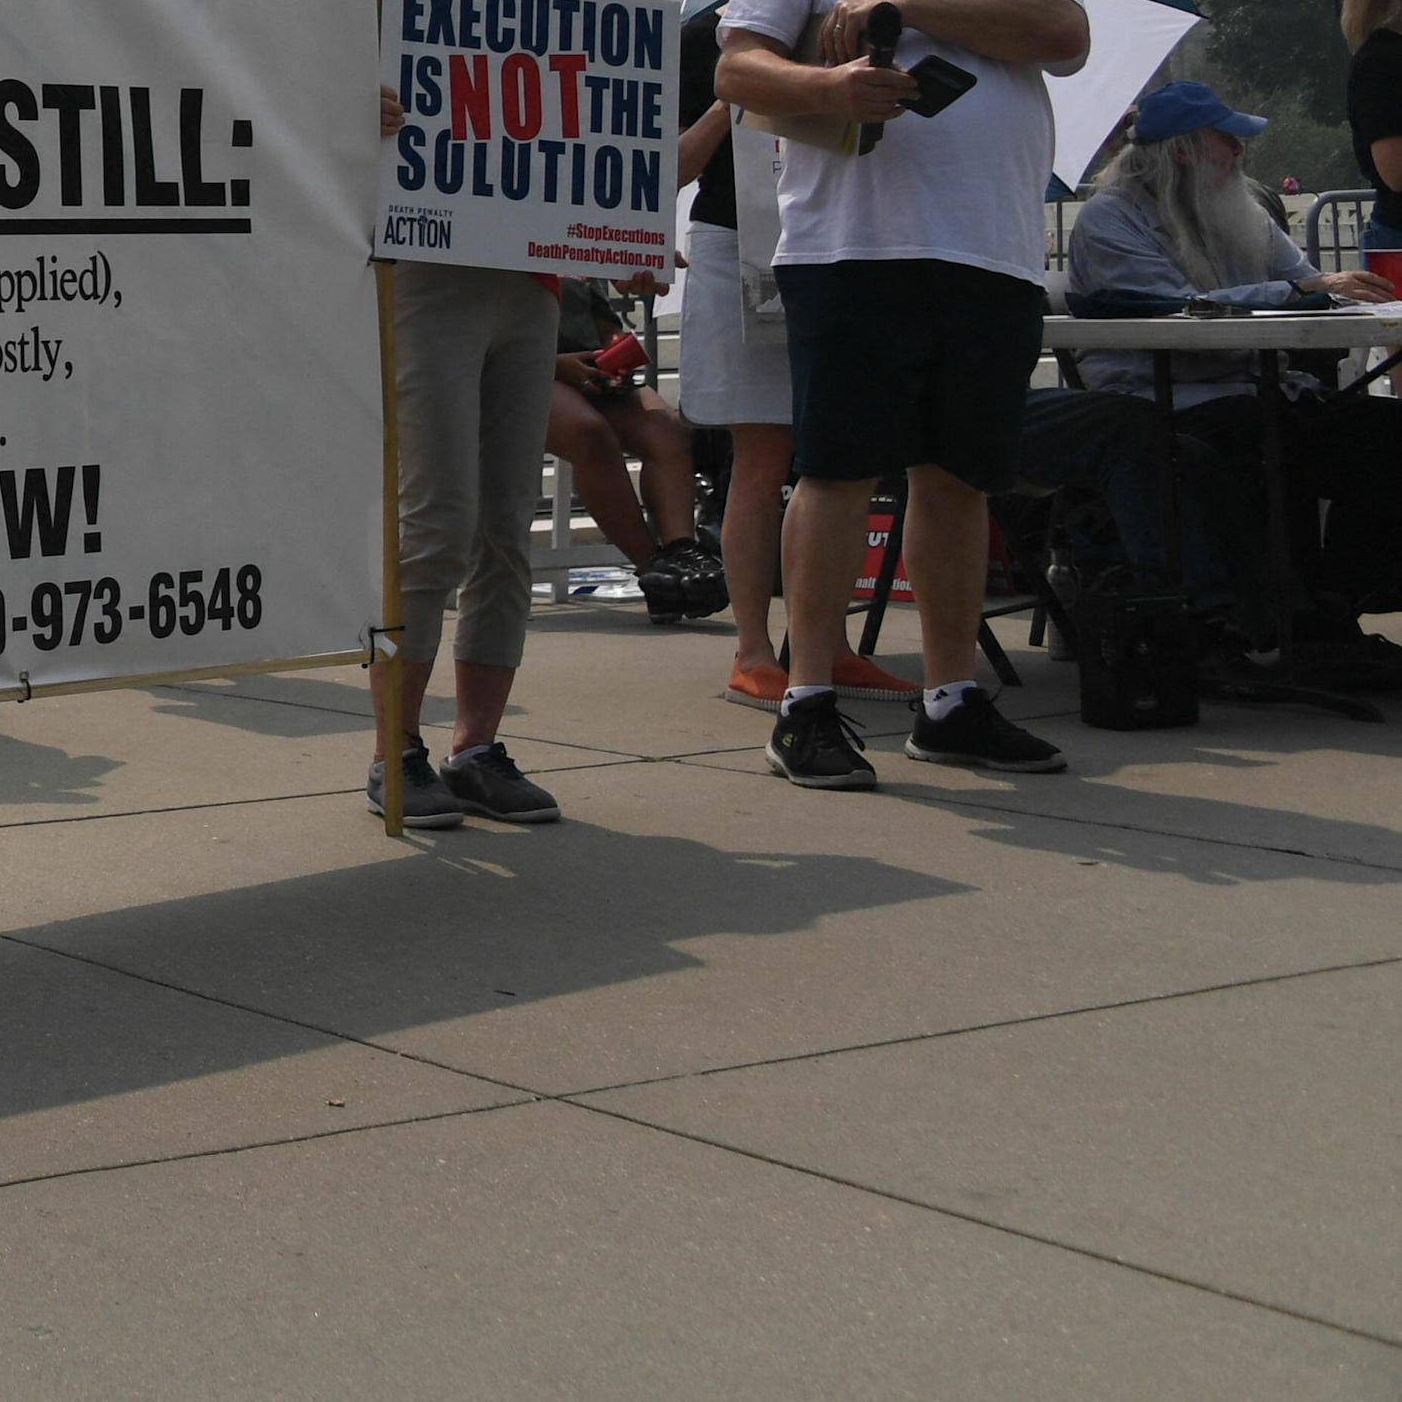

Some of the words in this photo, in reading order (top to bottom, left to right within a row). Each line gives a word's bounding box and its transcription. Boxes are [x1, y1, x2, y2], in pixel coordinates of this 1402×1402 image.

[400, 53, 443, 118] IS
[448, 52, 587, 142] NOT
[584, 74, 663, 140] THE
[397, 124, 661, 213] SOLUTION
[382, 214, 452, 250] ACTION
[566, 222, 666, 246] #StopExecutions
[527, 241, 665, 270] DeathPenaltyAction.org
